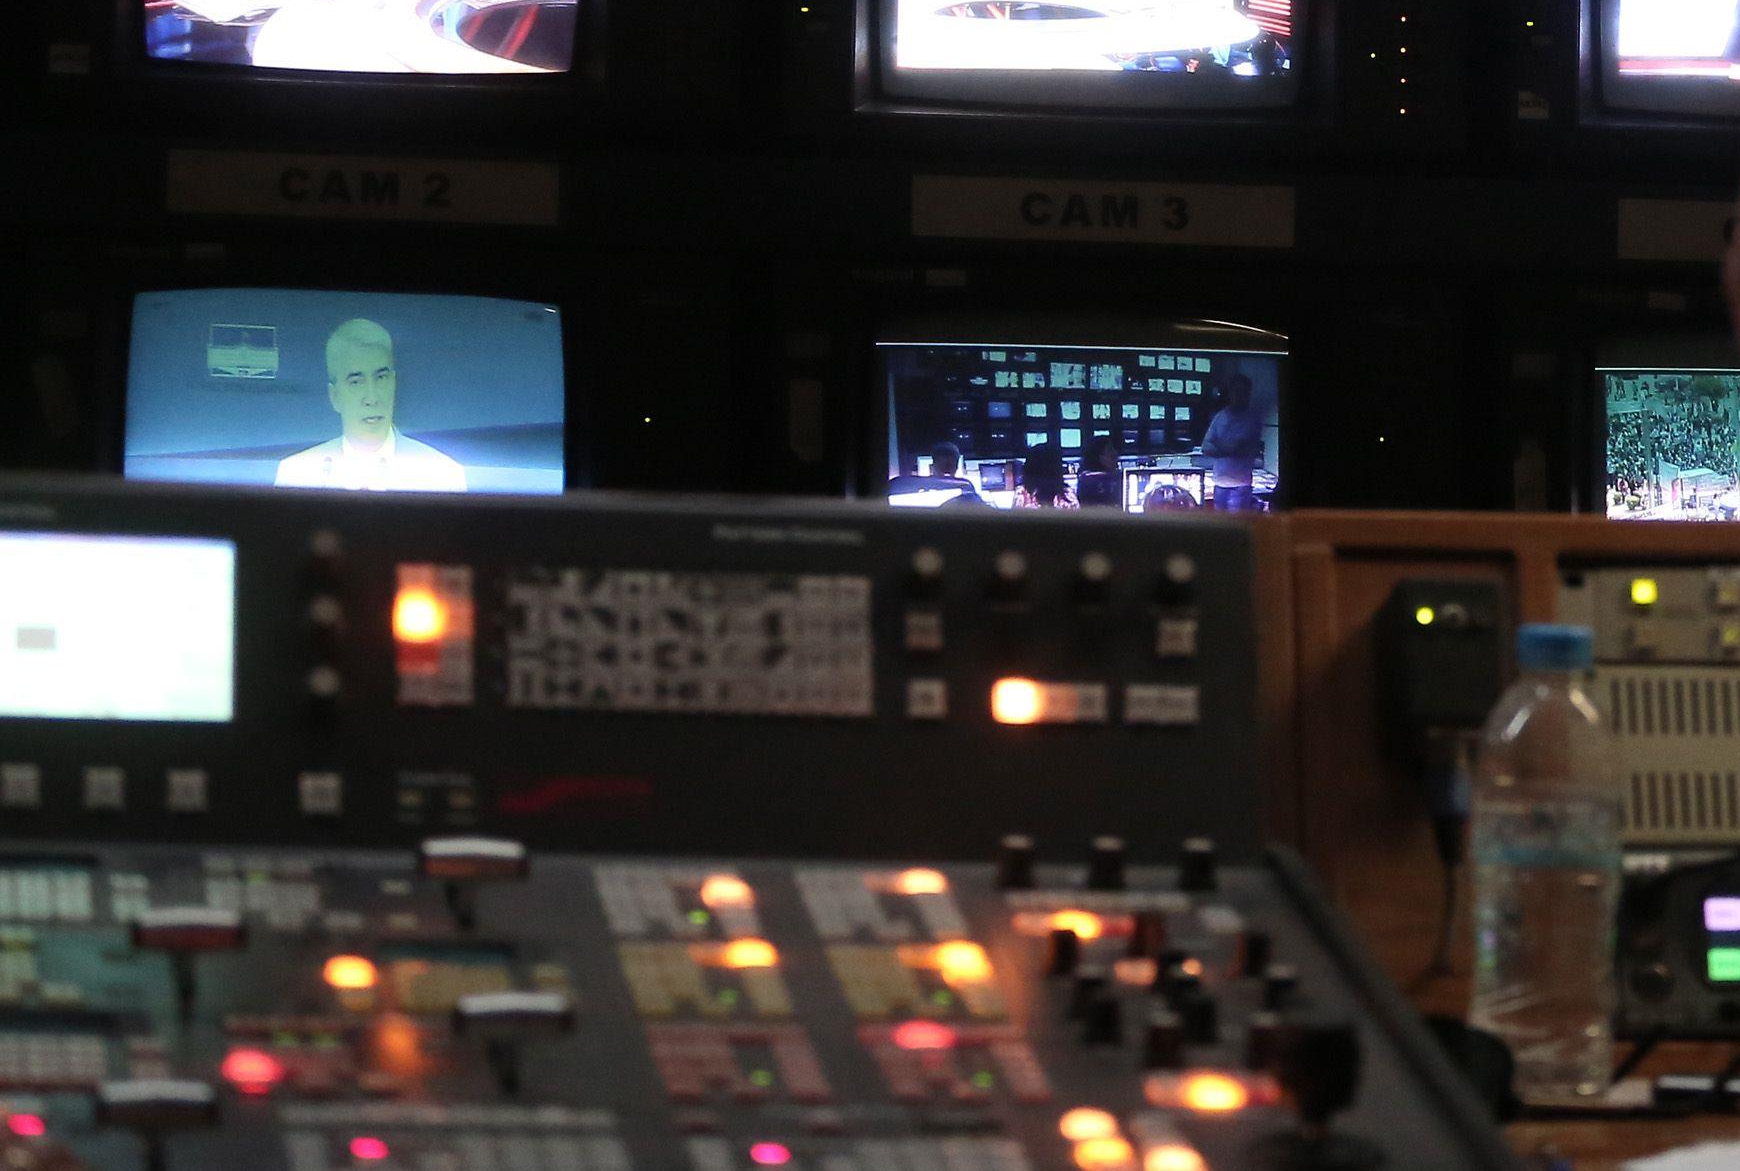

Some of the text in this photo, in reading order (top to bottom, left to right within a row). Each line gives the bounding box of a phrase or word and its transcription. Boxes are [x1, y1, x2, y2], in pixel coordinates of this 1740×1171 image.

[278, 167, 451, 208] CAM 2
[1020, 191, 1190, 230] CAM 3
